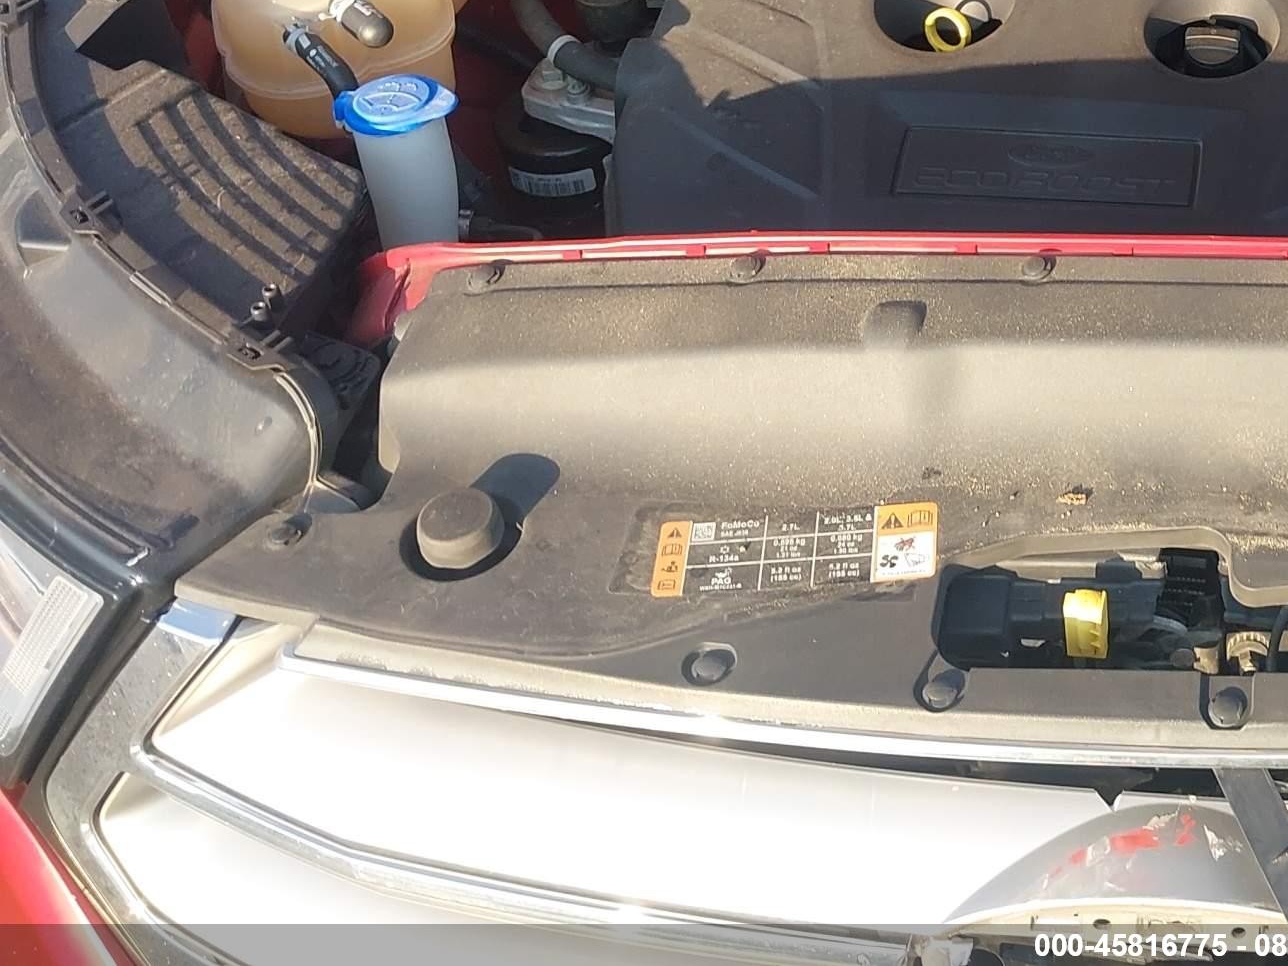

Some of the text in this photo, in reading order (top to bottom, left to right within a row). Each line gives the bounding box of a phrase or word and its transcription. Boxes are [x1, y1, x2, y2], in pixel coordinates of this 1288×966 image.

[721, 520, 760, 530] FoMoCo
[708, 554, 739, 563] R-134a
[711, 576, 732, 586] PAG
